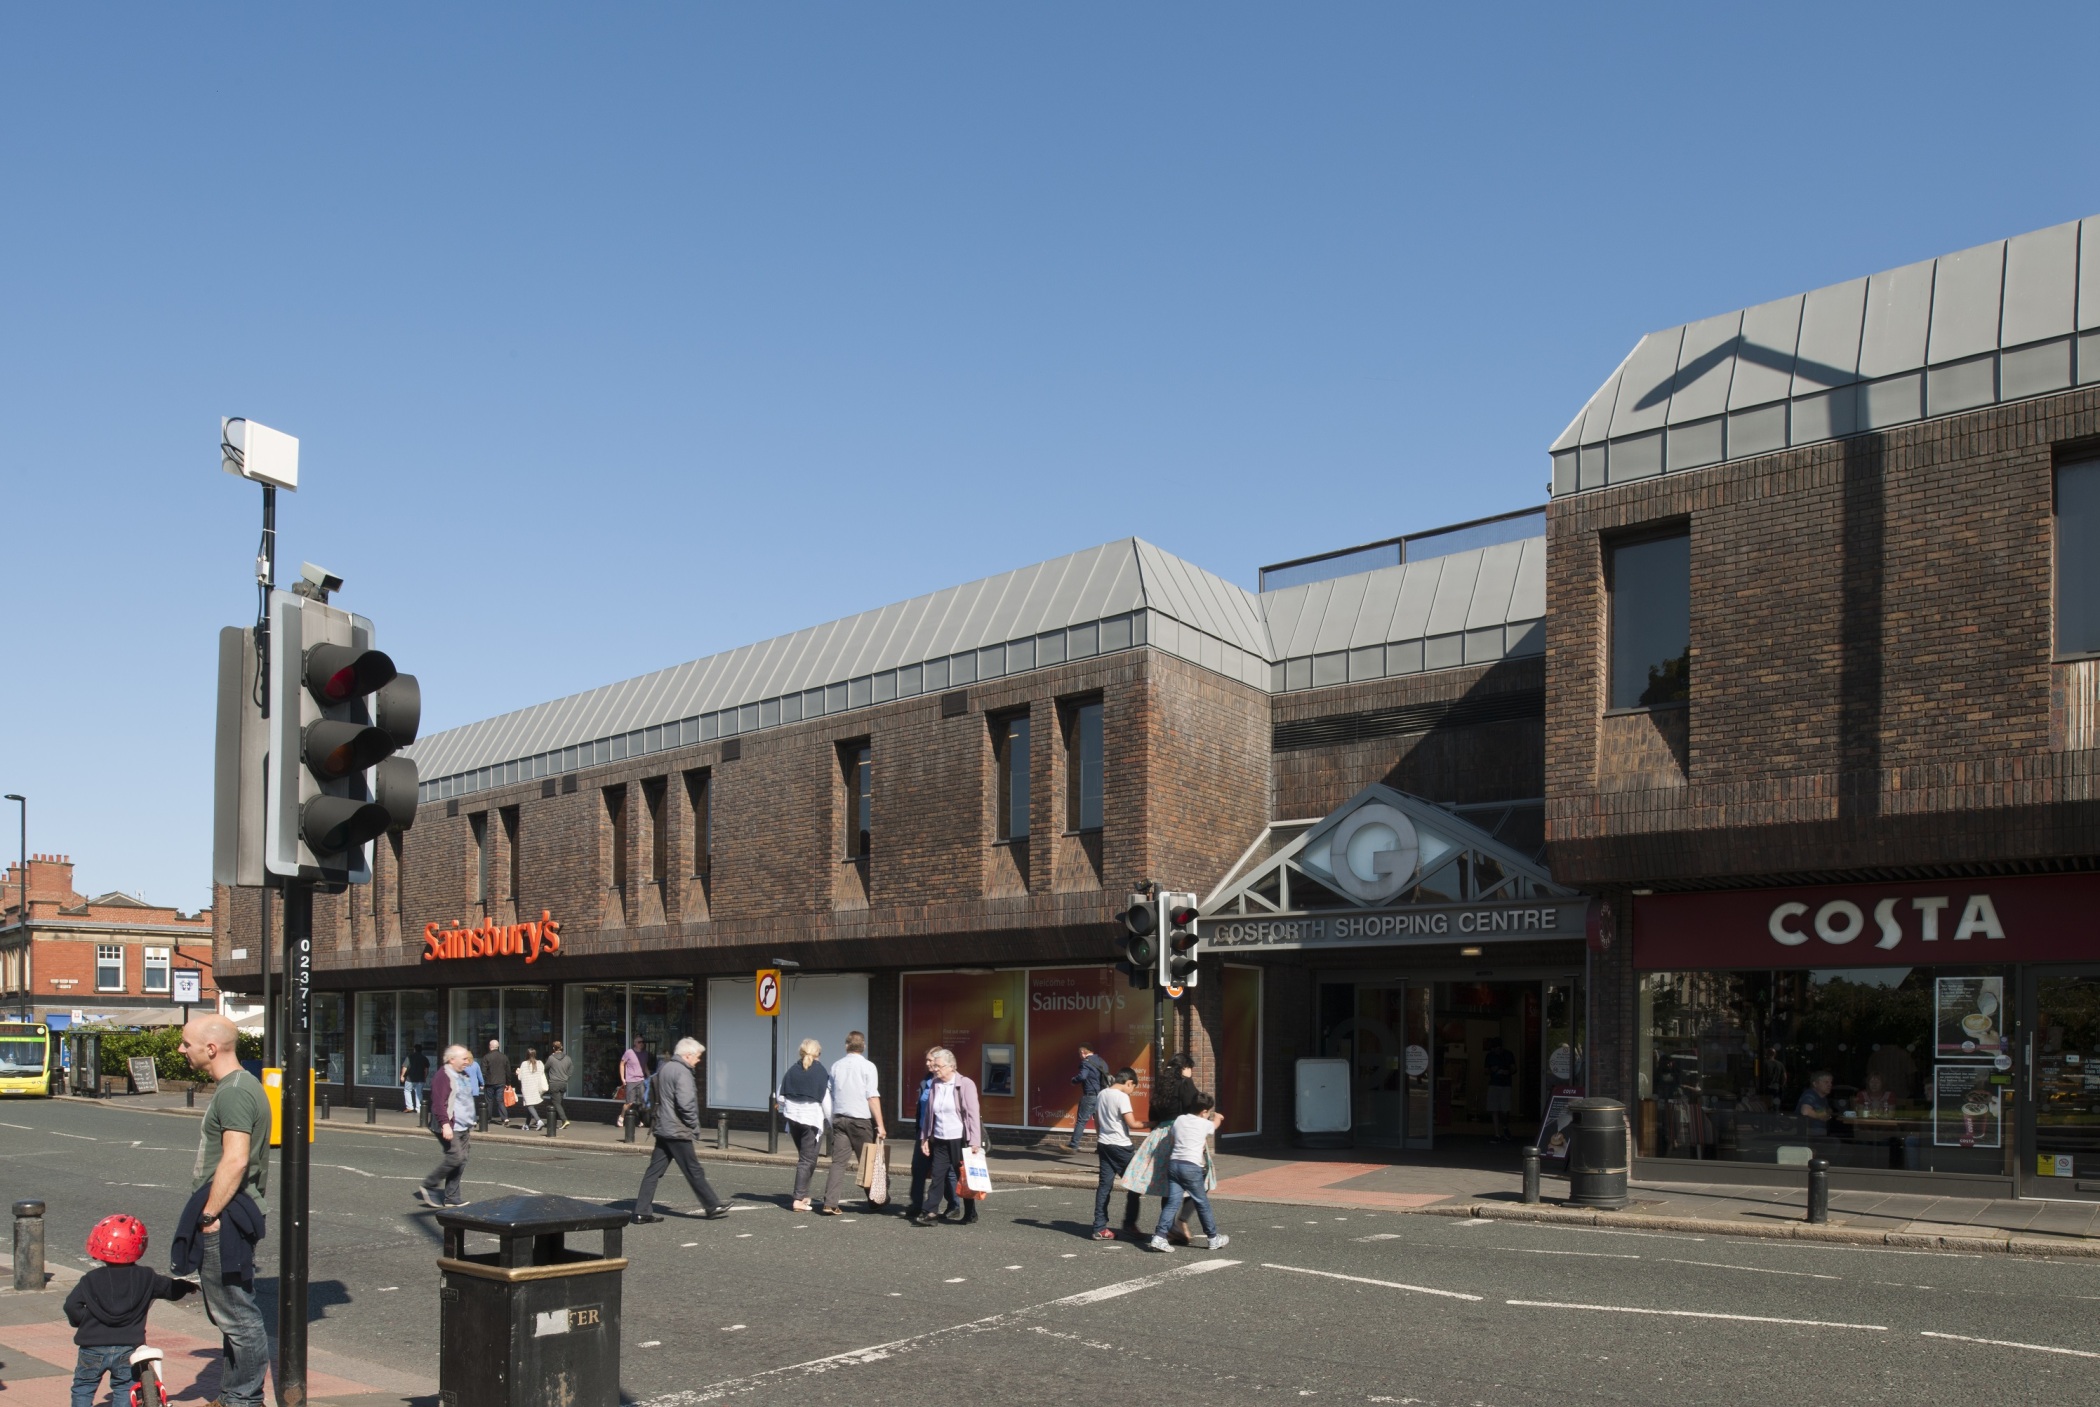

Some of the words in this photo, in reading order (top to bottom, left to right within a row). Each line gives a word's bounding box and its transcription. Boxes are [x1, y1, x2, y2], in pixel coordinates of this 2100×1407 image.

[424, 908, 560, 964] Sainsbury's
[1214, 920, 1325, 944] GOSFORTH
[1334, 913, 1448, 938] SHOPPING
[1458, 908, 1557, 933] CENTRE
[1768, 893, 2006, 950] COSTA
[1032, 978, 1065, 988] Welcome
[1067, 978, 1076, 987] to
[1032, 990, 1126, 1014] Sainsbury's
[1032, 1105, 1044, 1124] Try
[1044, 1108, 1076, 1125] something
